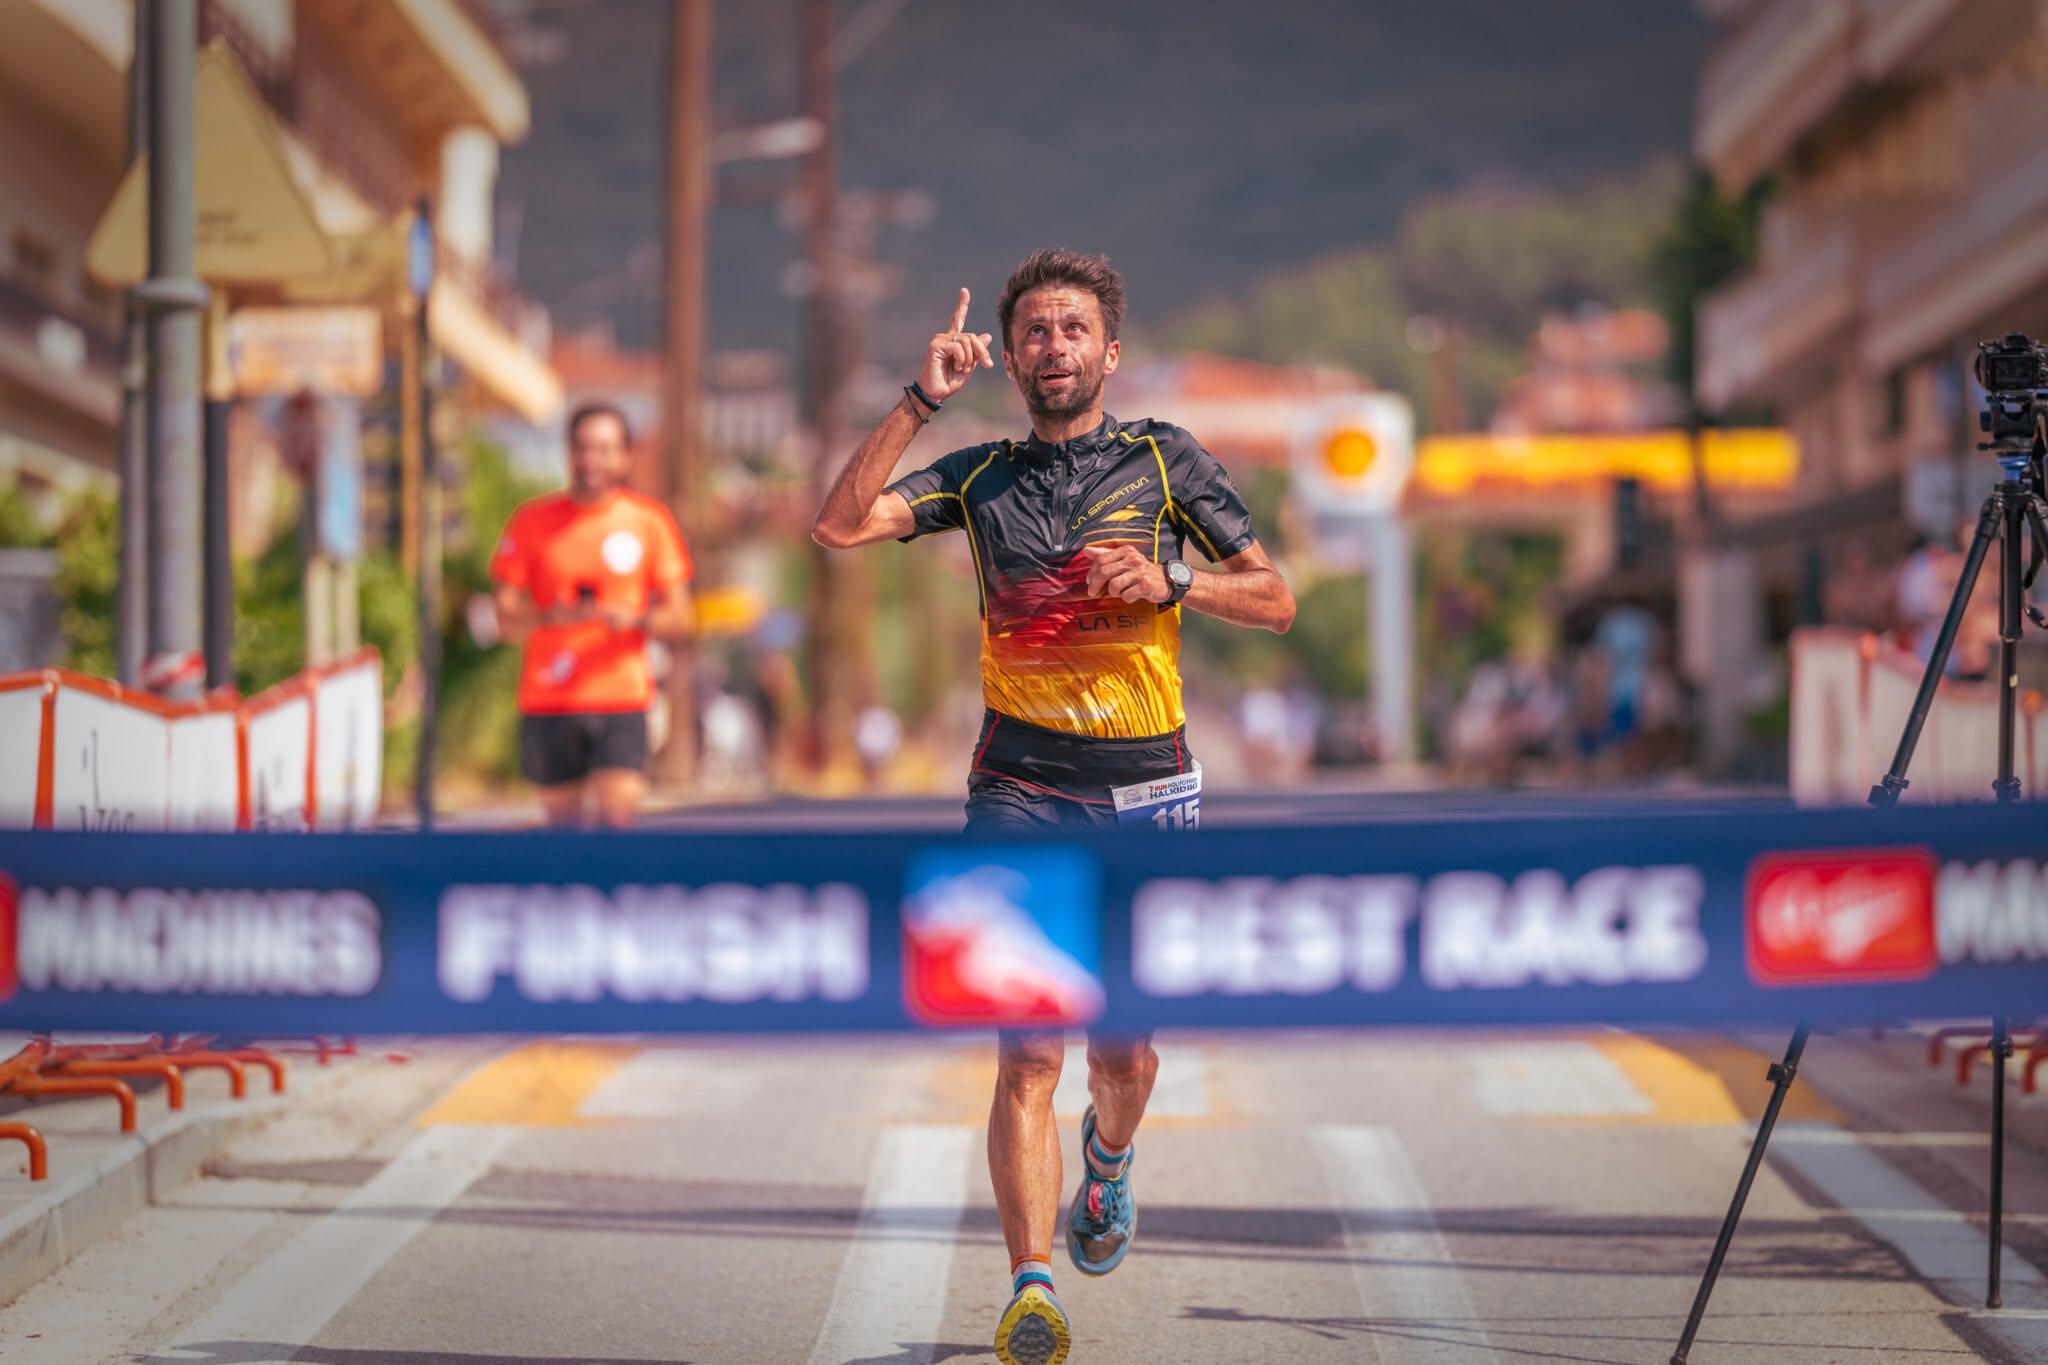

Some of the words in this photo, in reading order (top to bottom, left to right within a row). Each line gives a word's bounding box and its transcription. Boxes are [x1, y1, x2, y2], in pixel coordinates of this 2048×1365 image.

[1071, 515, 1087, 530] LA
[1087, 476, 1149, 516] SPORTIVA
[1077, 616, 1111, 632] LA
[1149, 782, 1198, 800] HALKIDIKI
[1154, 783, 1168, 792] RUN
[1152, 798, 1200, 832] 115
[439, 883, 868, 1001] FINISH
[1133, 875, 1418, 996] BEST
[1419, 865, 1707, 990] RACE
